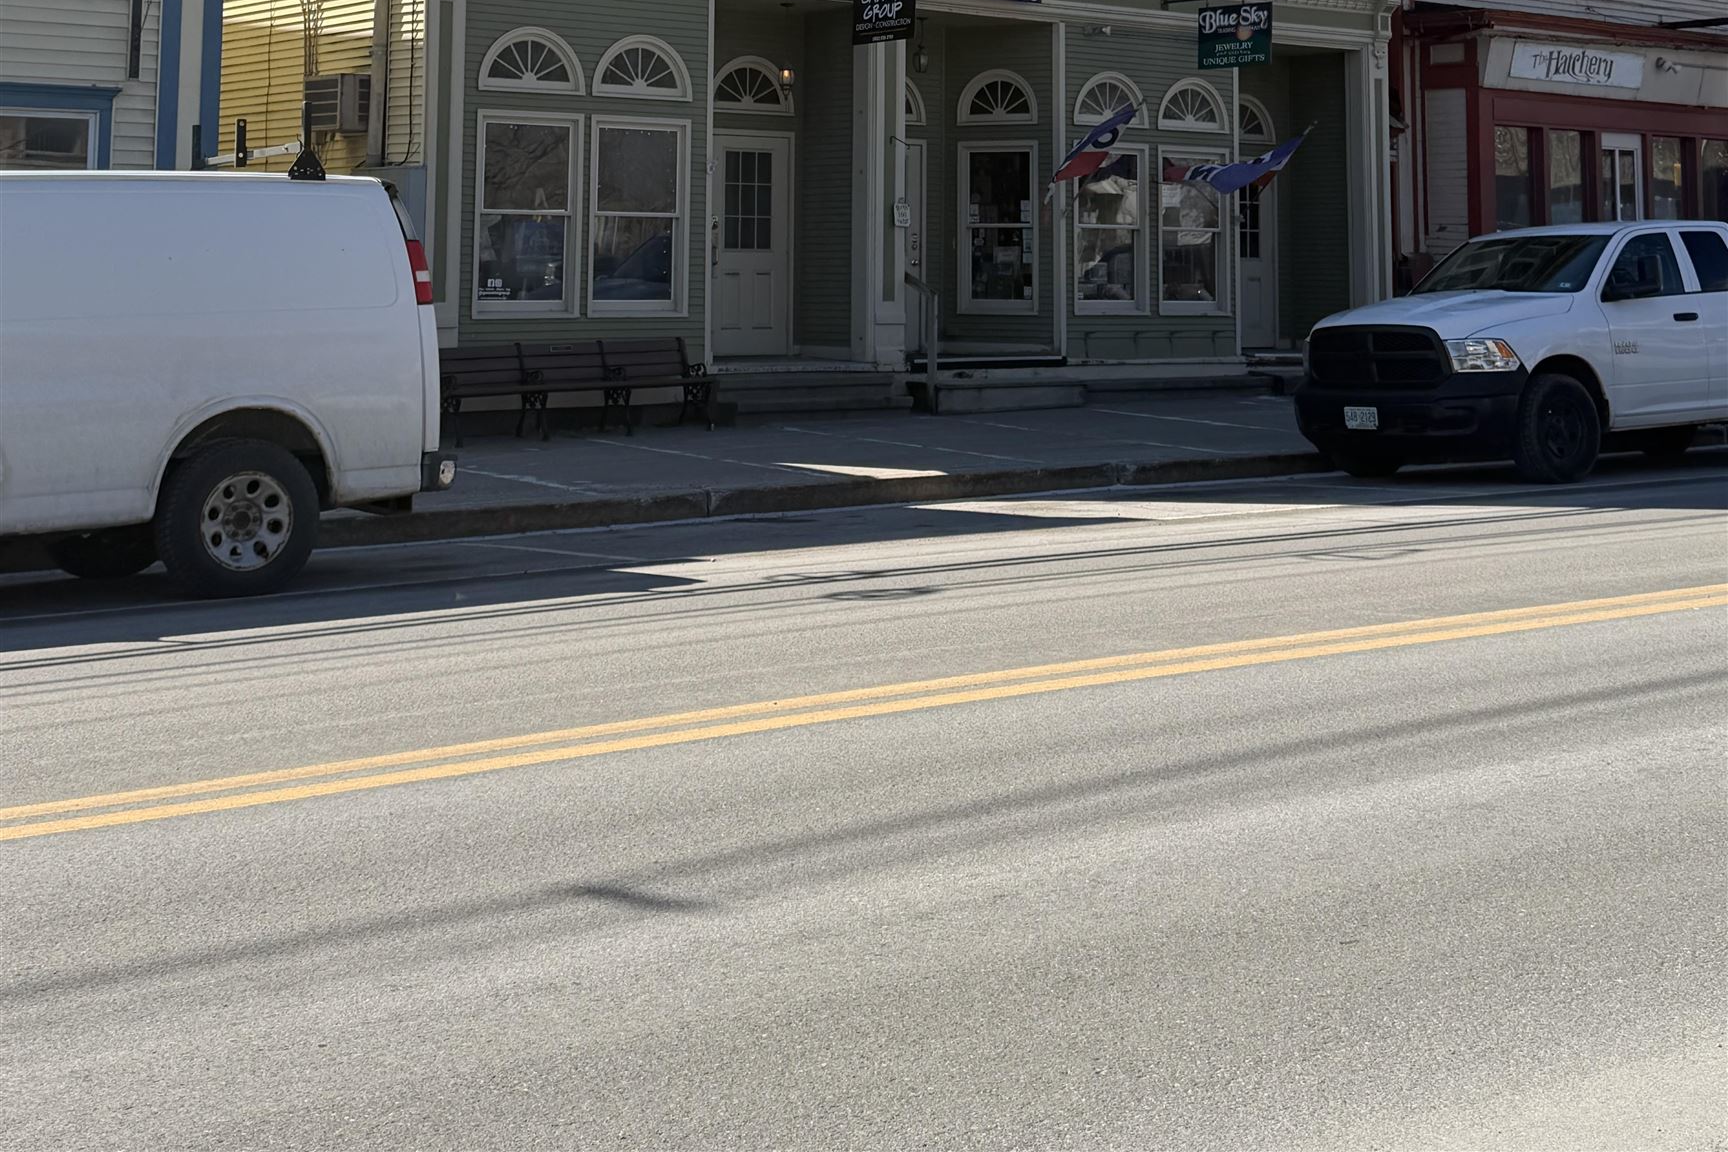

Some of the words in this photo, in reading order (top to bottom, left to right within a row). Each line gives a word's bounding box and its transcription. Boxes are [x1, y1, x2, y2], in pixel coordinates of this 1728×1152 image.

[863, 1, 903, 22] GROUP
[1199, 9, 1239, 34] Blue
[1239, 5, 1269, 28] Sky
[1215, 41, 1254, 53] JEWELRY
[1203, 56, 1237, 66] UNIQUE
[1238, 54, 1265, 64] GIFTS
[1546, 49, 1615, 84] Hatchery
